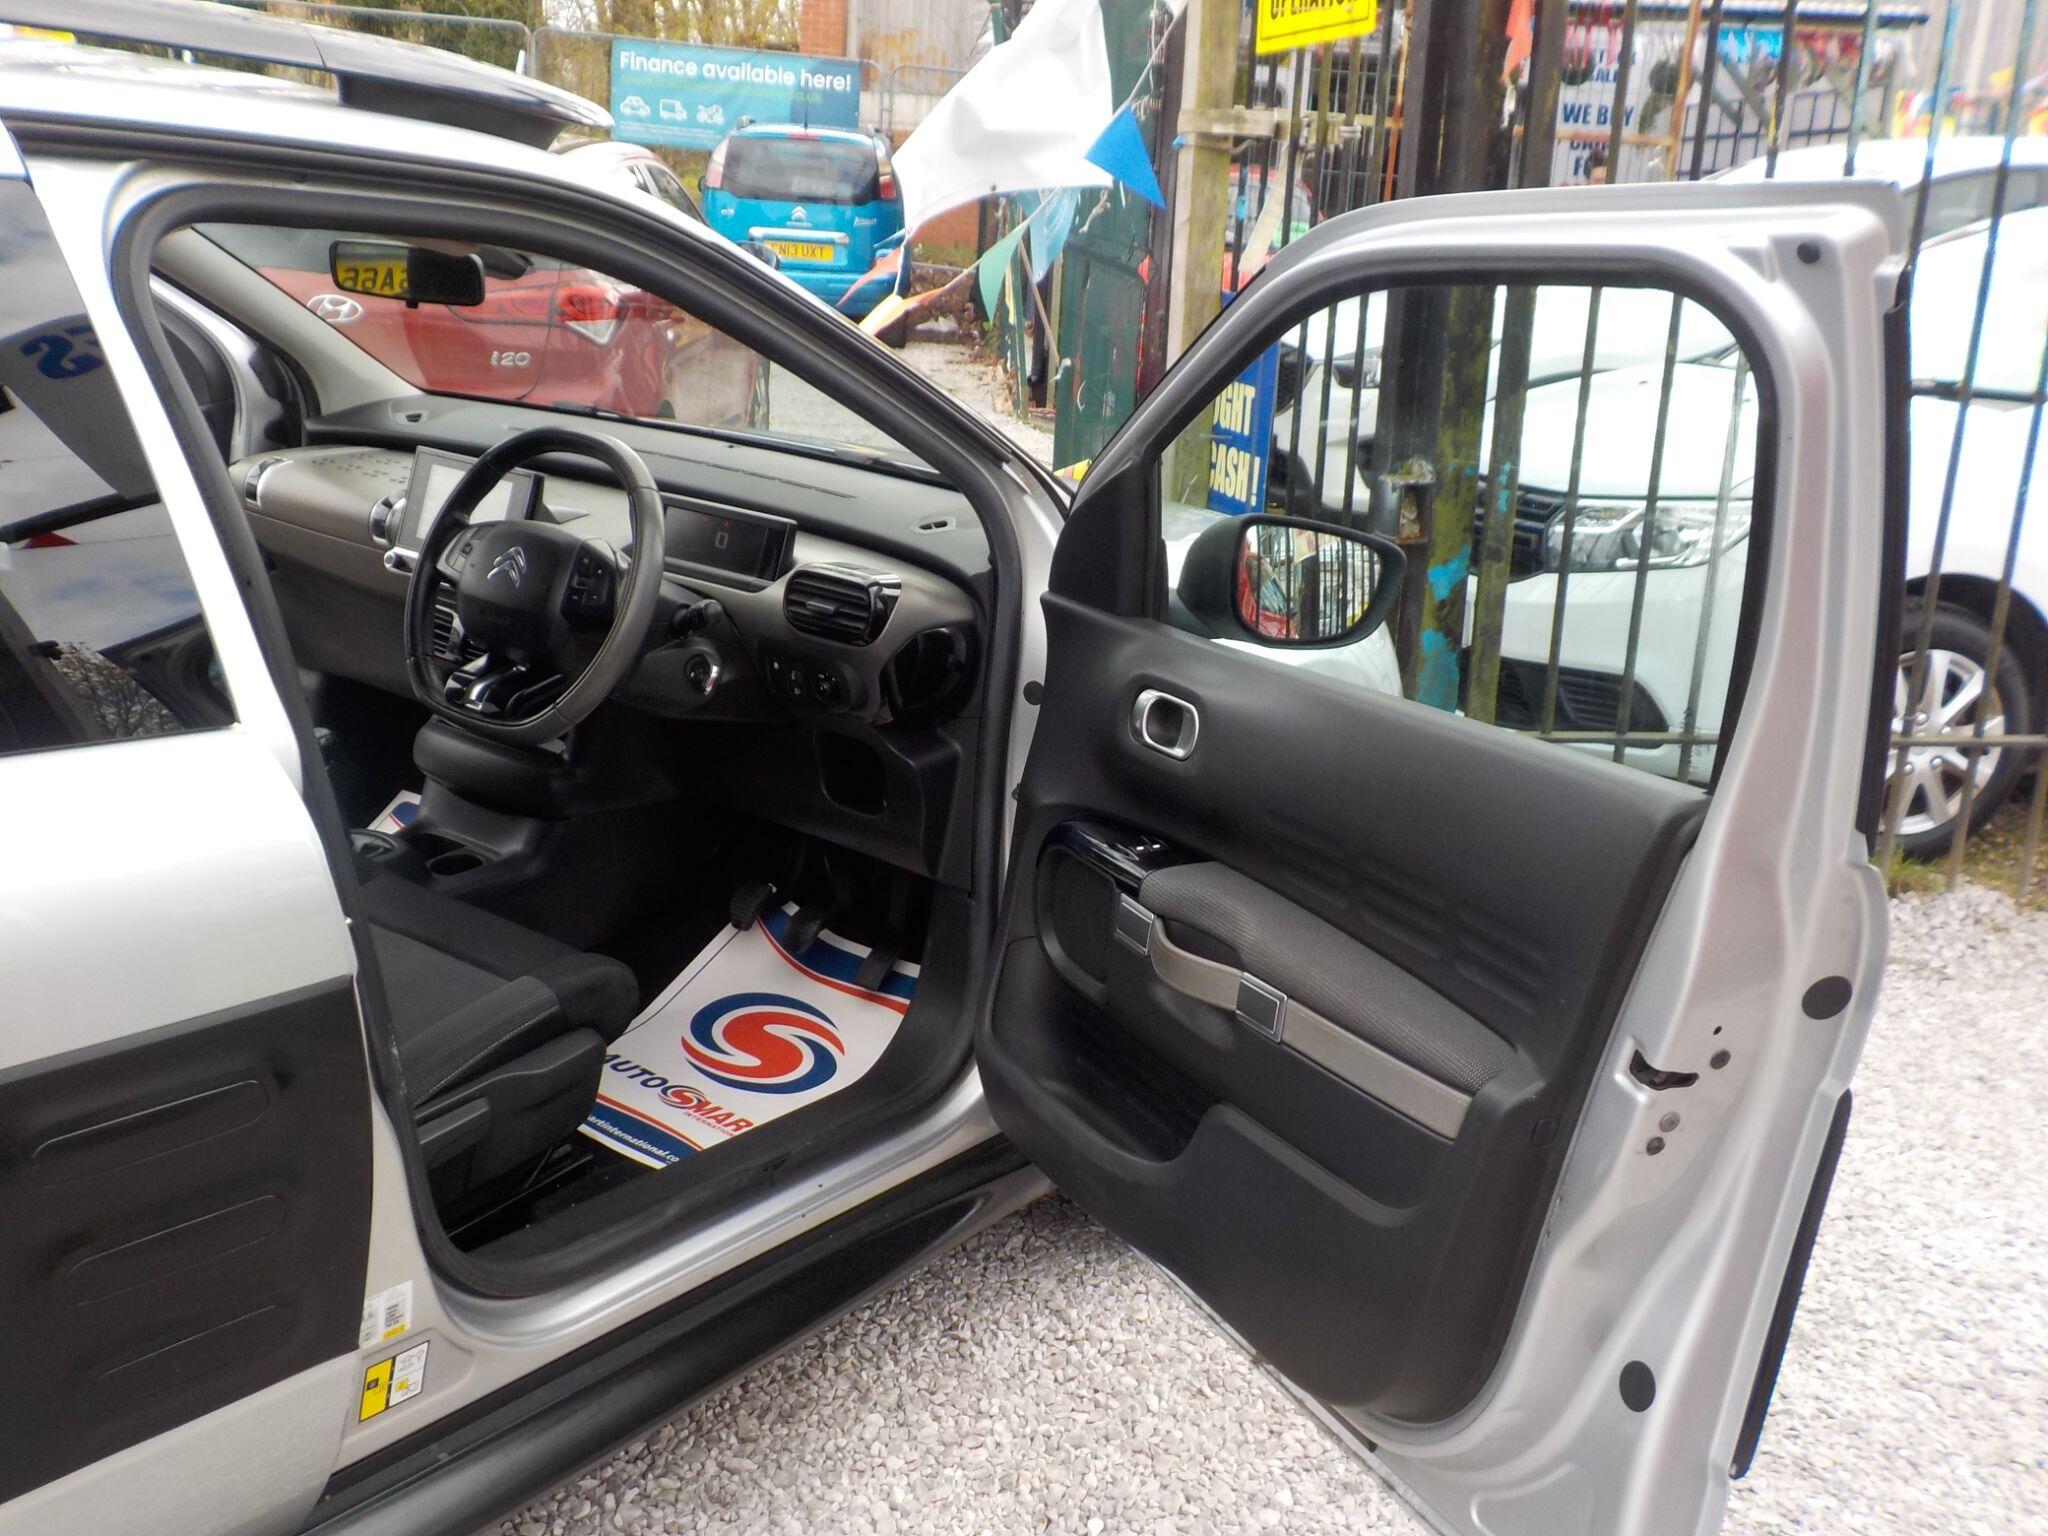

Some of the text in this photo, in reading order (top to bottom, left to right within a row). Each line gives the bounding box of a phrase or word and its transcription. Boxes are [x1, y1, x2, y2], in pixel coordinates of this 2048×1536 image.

[620, 51, 697, 76] Finance
[703, 62, 795, 86] available
[801, 68, 851, 91] here!
[1563, 103, 1634, 126] WE BY
[801, 244, 825, 258] UXT
